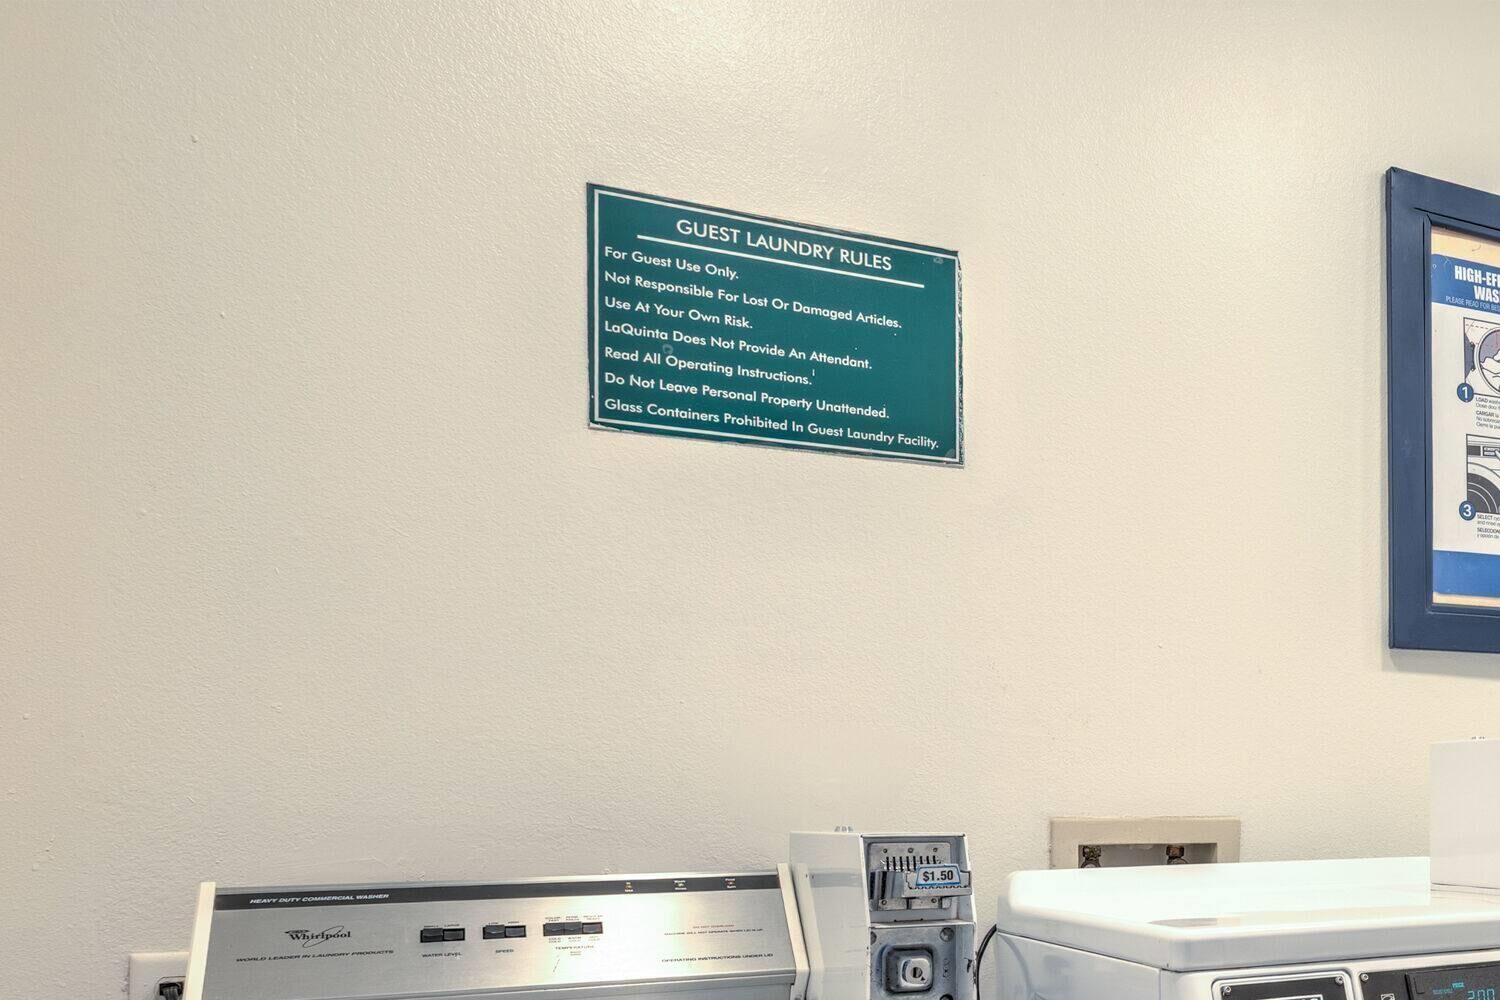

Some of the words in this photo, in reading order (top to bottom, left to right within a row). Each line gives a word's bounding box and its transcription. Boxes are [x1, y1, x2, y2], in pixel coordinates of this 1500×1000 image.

[676, 220, 740, 243] GUEST
[747, 232, 834, 260] LAUNDRY
[840, 249, 892, 270] RULES
[605, 246, 627, 259] For
[632, 252, 671, 267] Guest
[676, 258, 700, 272] Use
[705, 264, 738, 280] Only.
[605, 271, 630, 284] Not
[636, 276, 713, 298] Responsible
[718, 289, 739, 302] For
[744, 294, 768, 306] Lost
[772, 298, 789, 310] Or
[793, 302, 852, 320] Damaged
[856, 312, 901, 328] Articles.
[605, 296, 630, 310] Use
[635, 302, 650, 312] At
[654, 304, 684, 318] Your
[688, 310, 720, 323] Own
[725, 315, 752, 328] Risk.
[1446, 296, 1464, 305] PLEASE
[605, 321, 668, 340] LaQuinta
[673, 331, 706, 345] Does
[711, 336, 734, 349] Not
[739, 340, 785, 356] Provide
[789, 348, 806, 359] An
[810, 352, 872, 368] Attendant.
[606, 347, 638, 361] Read
[643, 353, 660, 364] All
[666, 356, 732, 376] Operating
[738, 366, 812, 384] Instructions.
[605, 372, 624, 384] Do
[630, 375, 655, 388] Not
[660, 380, 697, 394] Leave
[702, 385, 756, 401] Personal
[762, 393, 812, 410] Property
[816, 400, 889, 418] Unattended.
[1461, 387, 1468, 398] 1
[605, 399, 642, 412] Glass
[647, 404, 719, 422] Containers
[724, 413, 787, 430] Prohibited
[792, 422, 803, 432] In
[808, 424, 843, 436] Guest
[848, 428, 894, 444] Laundry
[898, 434, 938, 449] Facility.
[1463, 504, 1472, 516] 3
[923, 870, 953, 882] $1.50
[289, 931, 351, 941] Whirlpool
